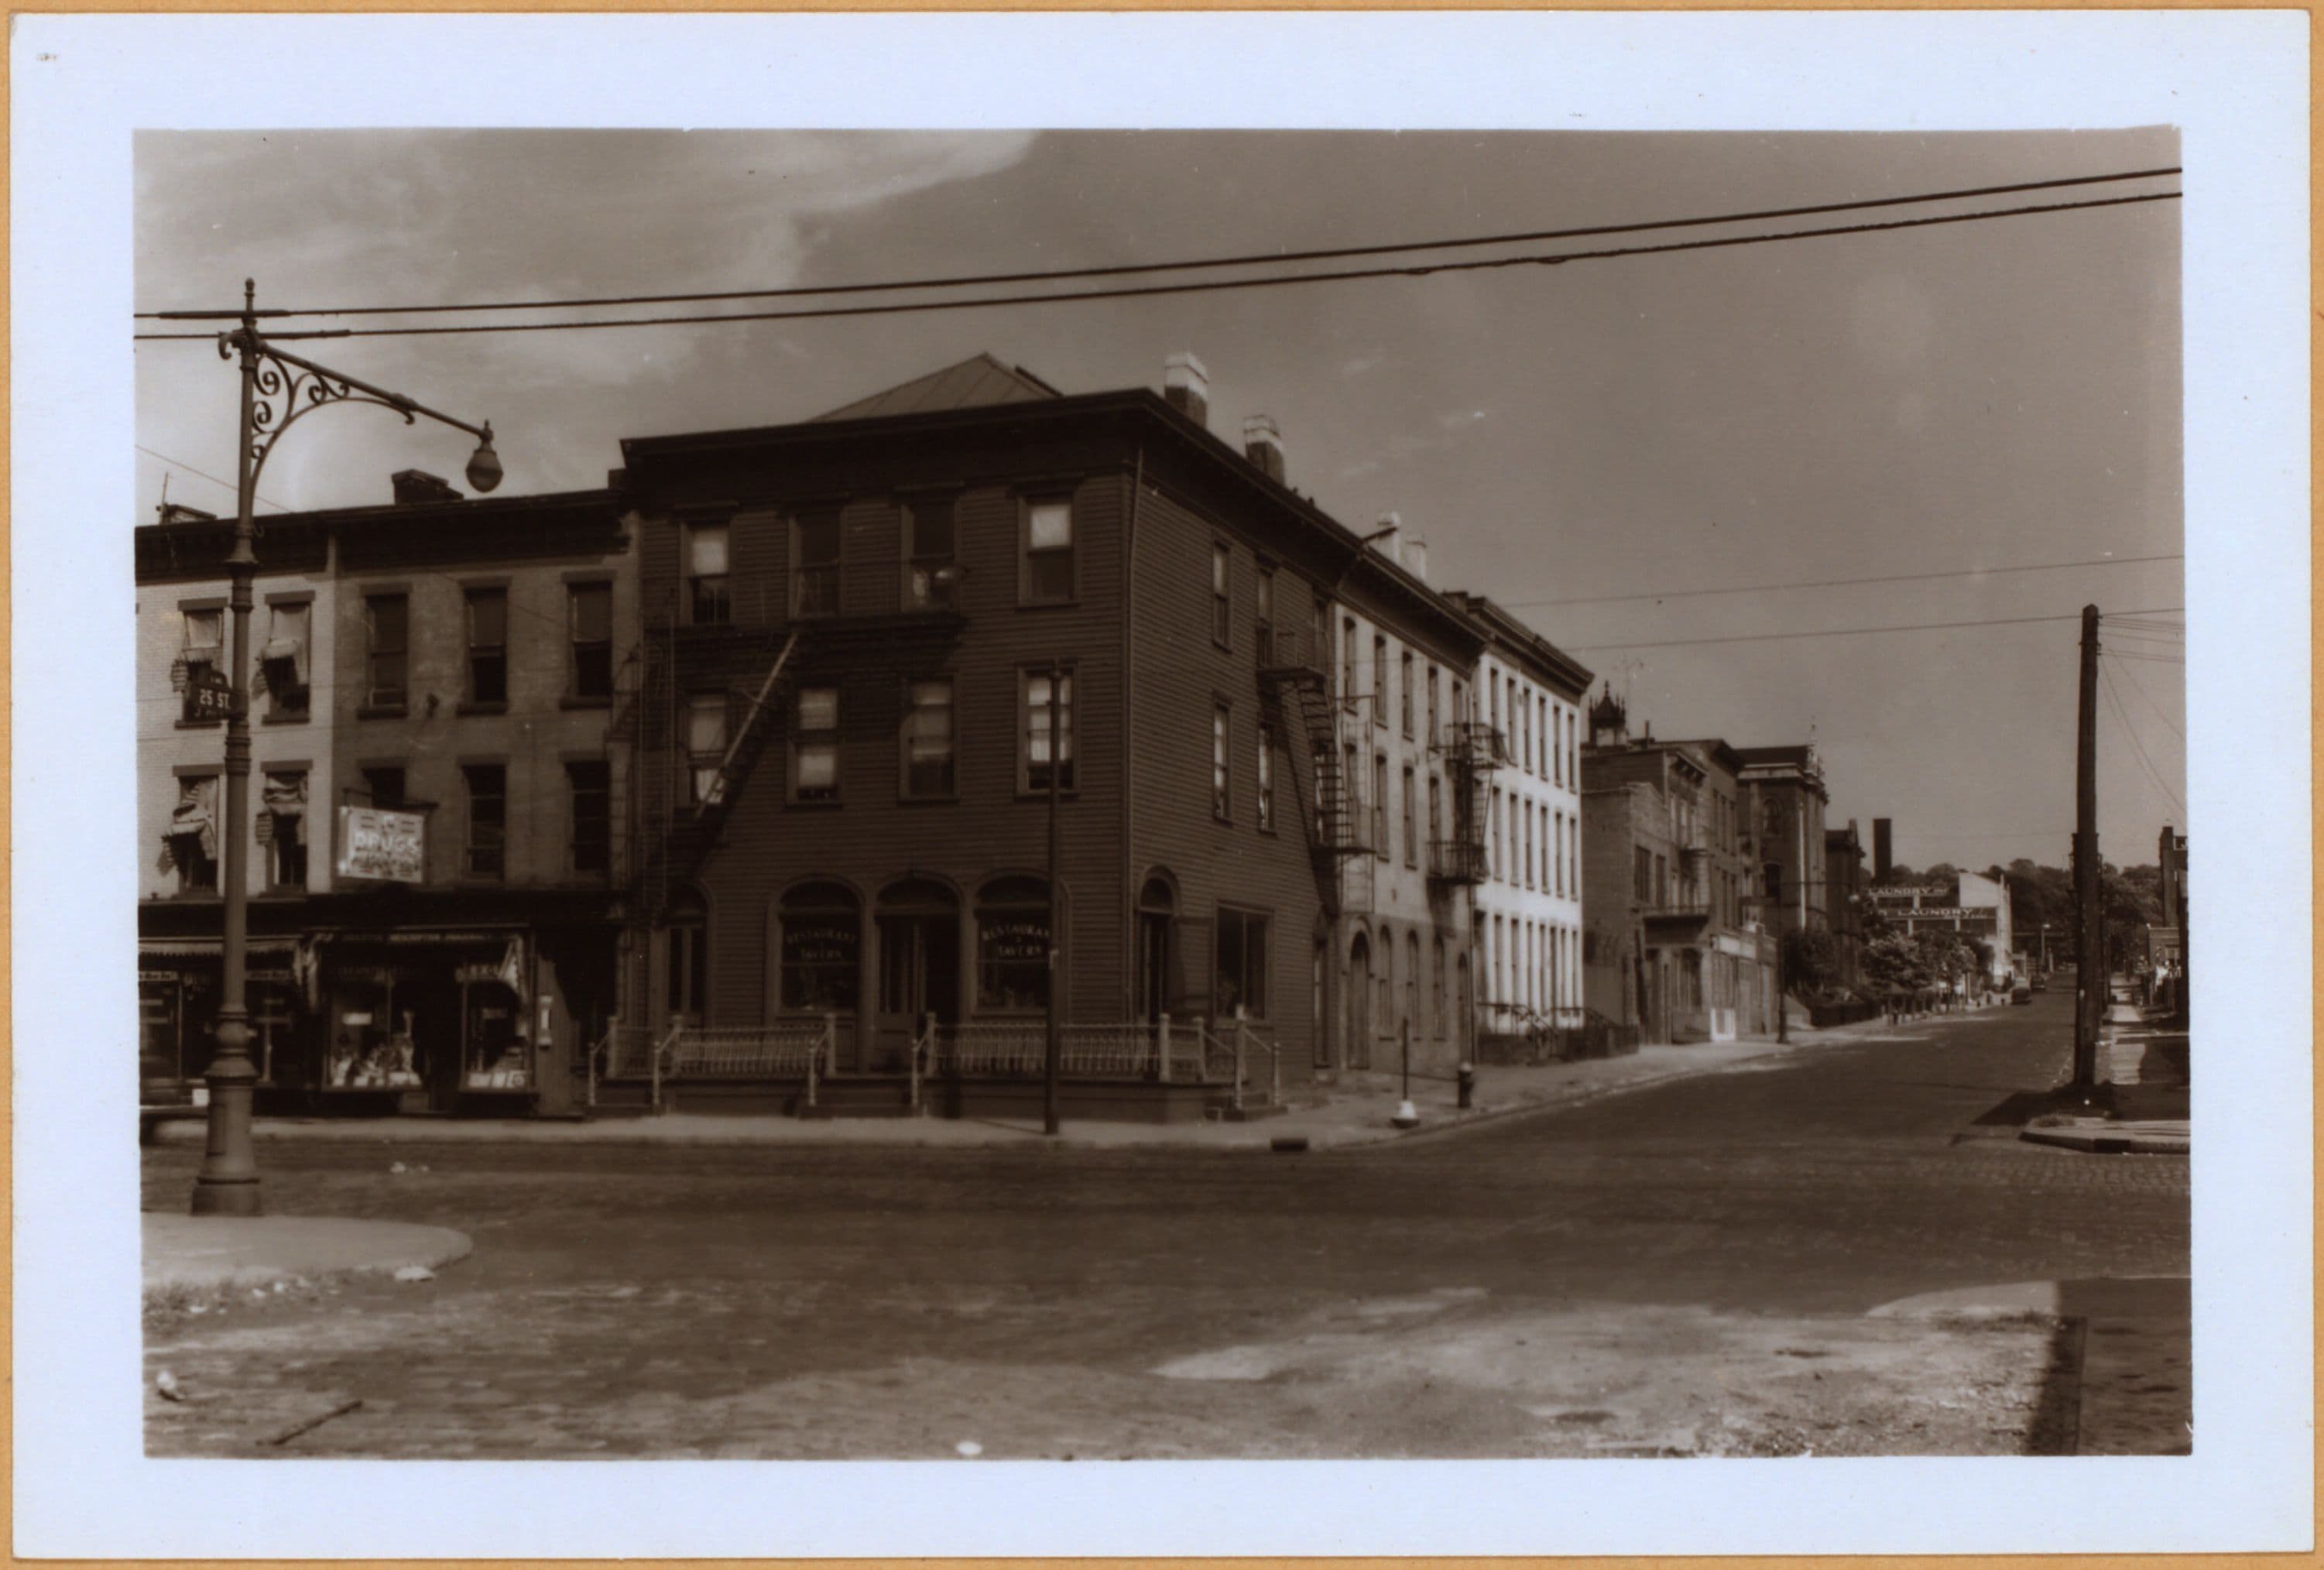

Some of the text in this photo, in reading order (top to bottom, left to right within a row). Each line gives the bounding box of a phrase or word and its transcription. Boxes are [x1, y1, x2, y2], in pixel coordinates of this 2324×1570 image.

[200, 688, 213, 706] 25
[355, 830, 419, 854] DRUGS
[1868, 886, 1932, 897] LAUNDRY
[1897, 909, 1973, 917] LAUNDRY
[786, 928, 857, 945] RESTAURANT
[800, 947, 844, 961] TAVERN
[997, 944, 1042, 958] TAVERN
